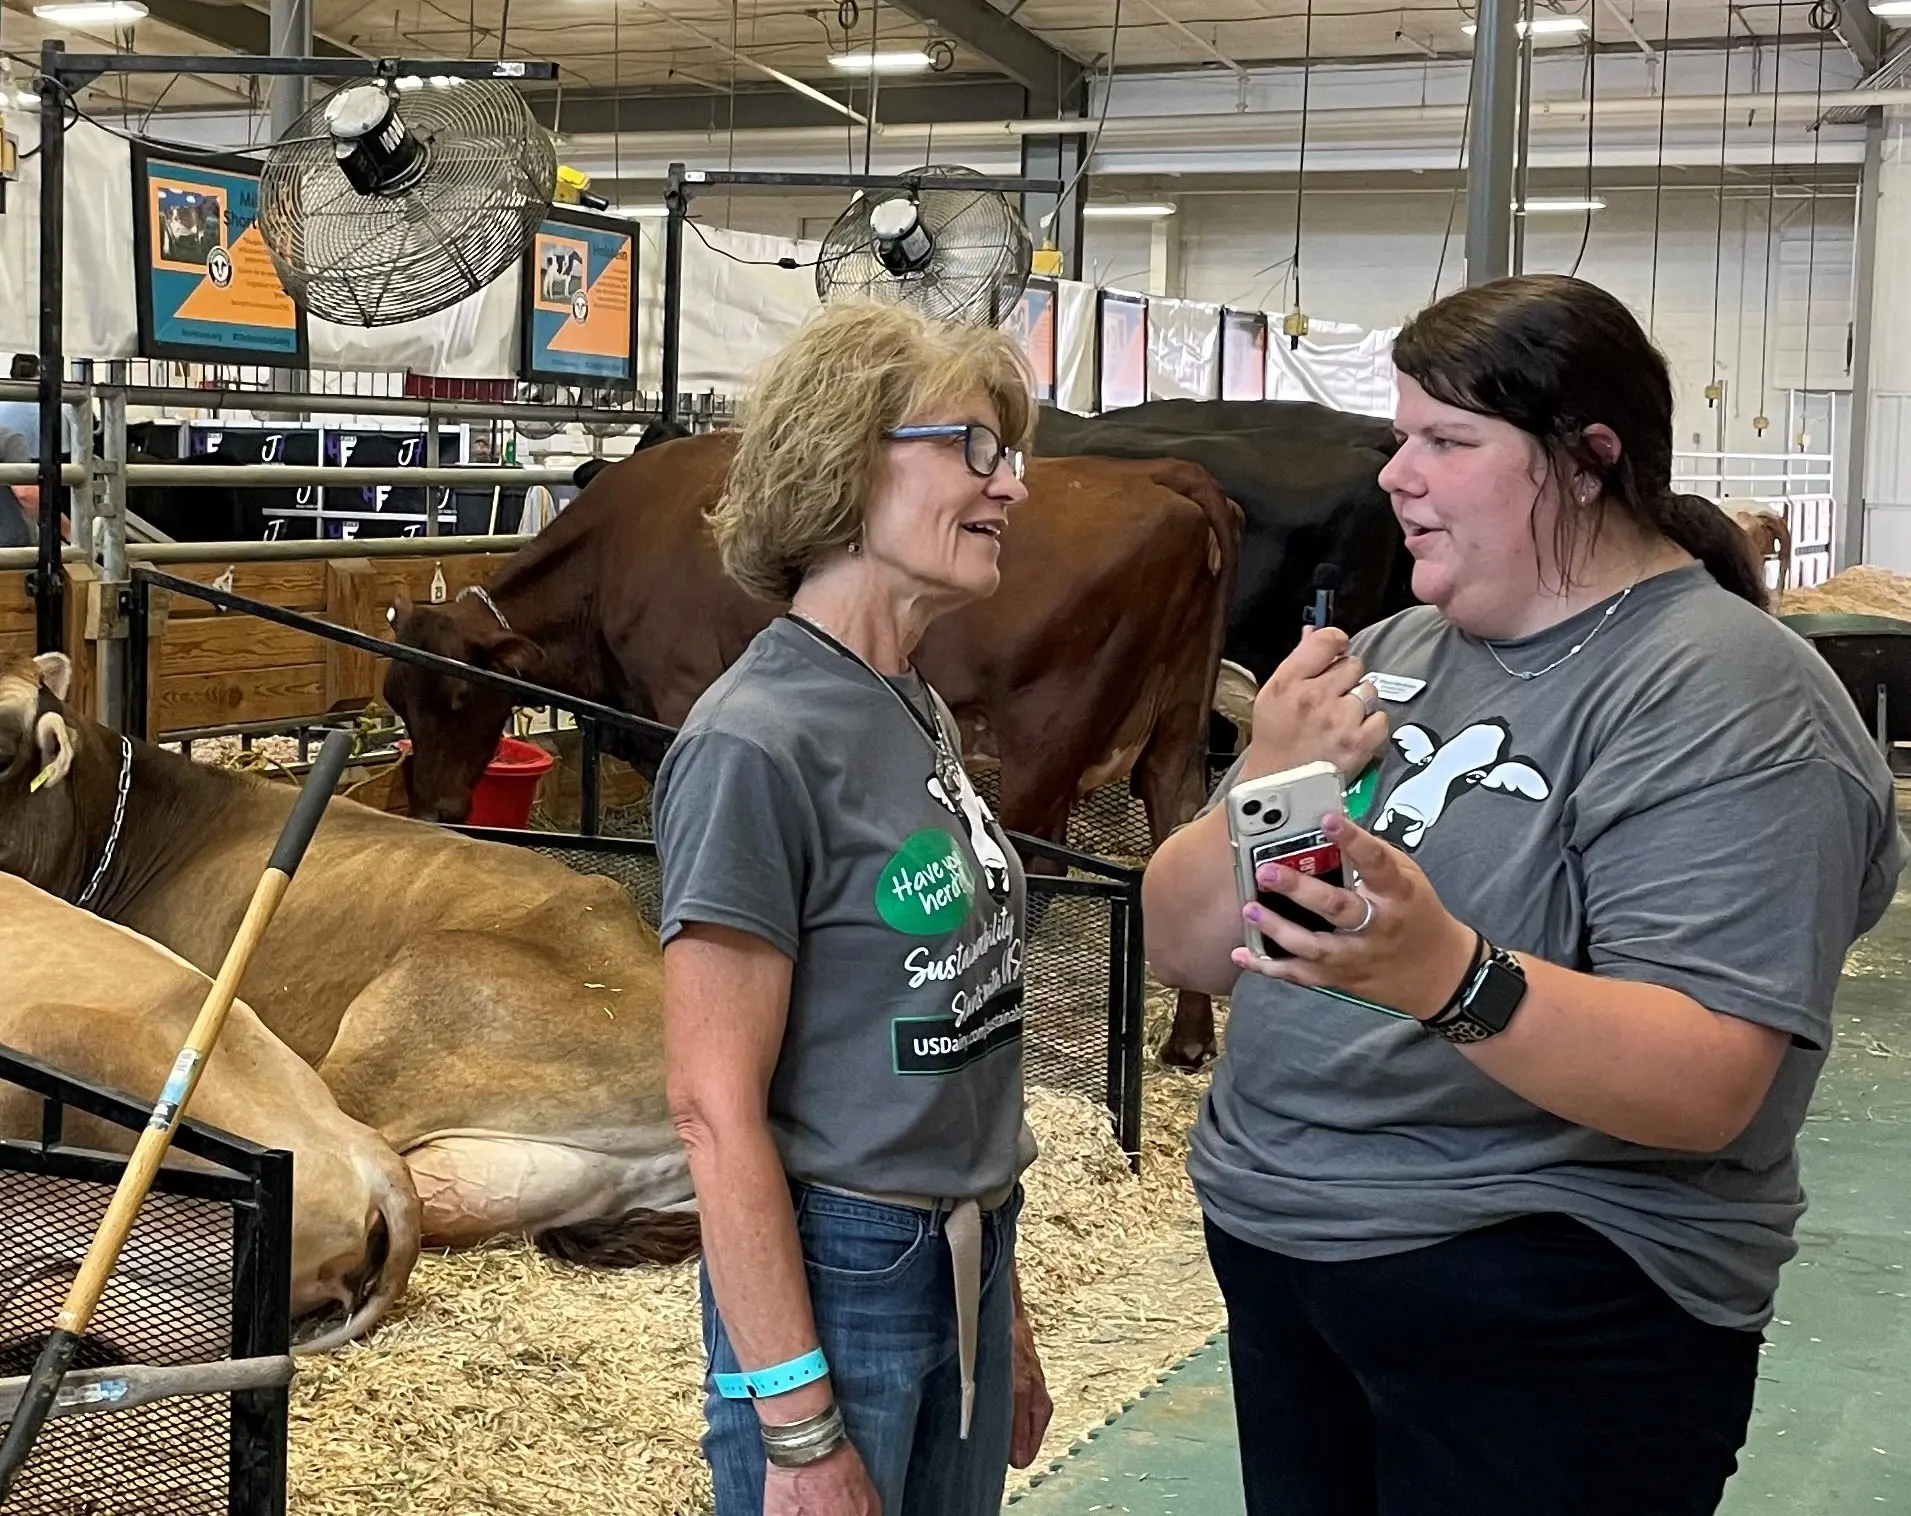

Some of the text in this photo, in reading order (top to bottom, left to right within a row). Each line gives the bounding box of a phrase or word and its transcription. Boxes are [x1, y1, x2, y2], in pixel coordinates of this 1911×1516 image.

[240, 190, 259, 209] Mil
[224, 209, 258, 230] Short
[892, 861, 944, 902] Have
